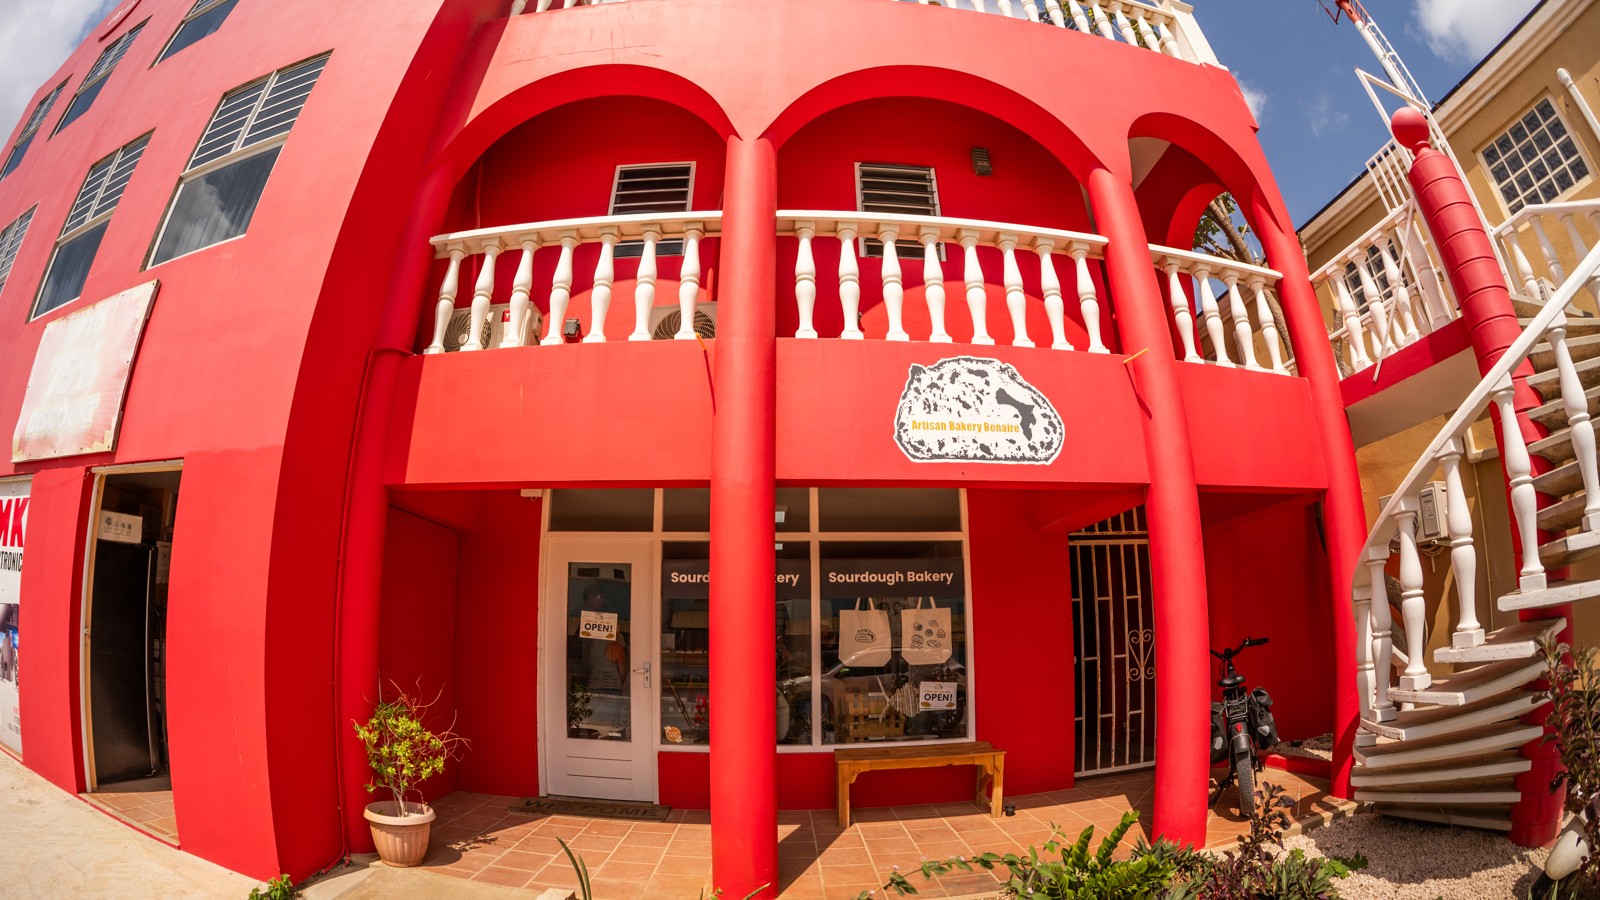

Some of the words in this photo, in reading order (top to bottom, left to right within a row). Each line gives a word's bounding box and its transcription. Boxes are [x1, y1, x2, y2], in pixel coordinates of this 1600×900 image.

[28, 400, 97, 434] DISCOUNT
[912, 420, 947, 431] Artisan
[949, 421, 982, 432] Bakery
[984, 422, 1020, 433] Bonaire
[0, 550, 23, 572] TRONIC
[774, 573, 800, 587] ery
[828, 571, 905, 586] Sourdough
[906, 570, 954, 585] Bakery
[584, 622, 613, 633] OPEN!
[924, 693, 952, 701] OPEN!
[524, 799, 658, 817] WELCOME
